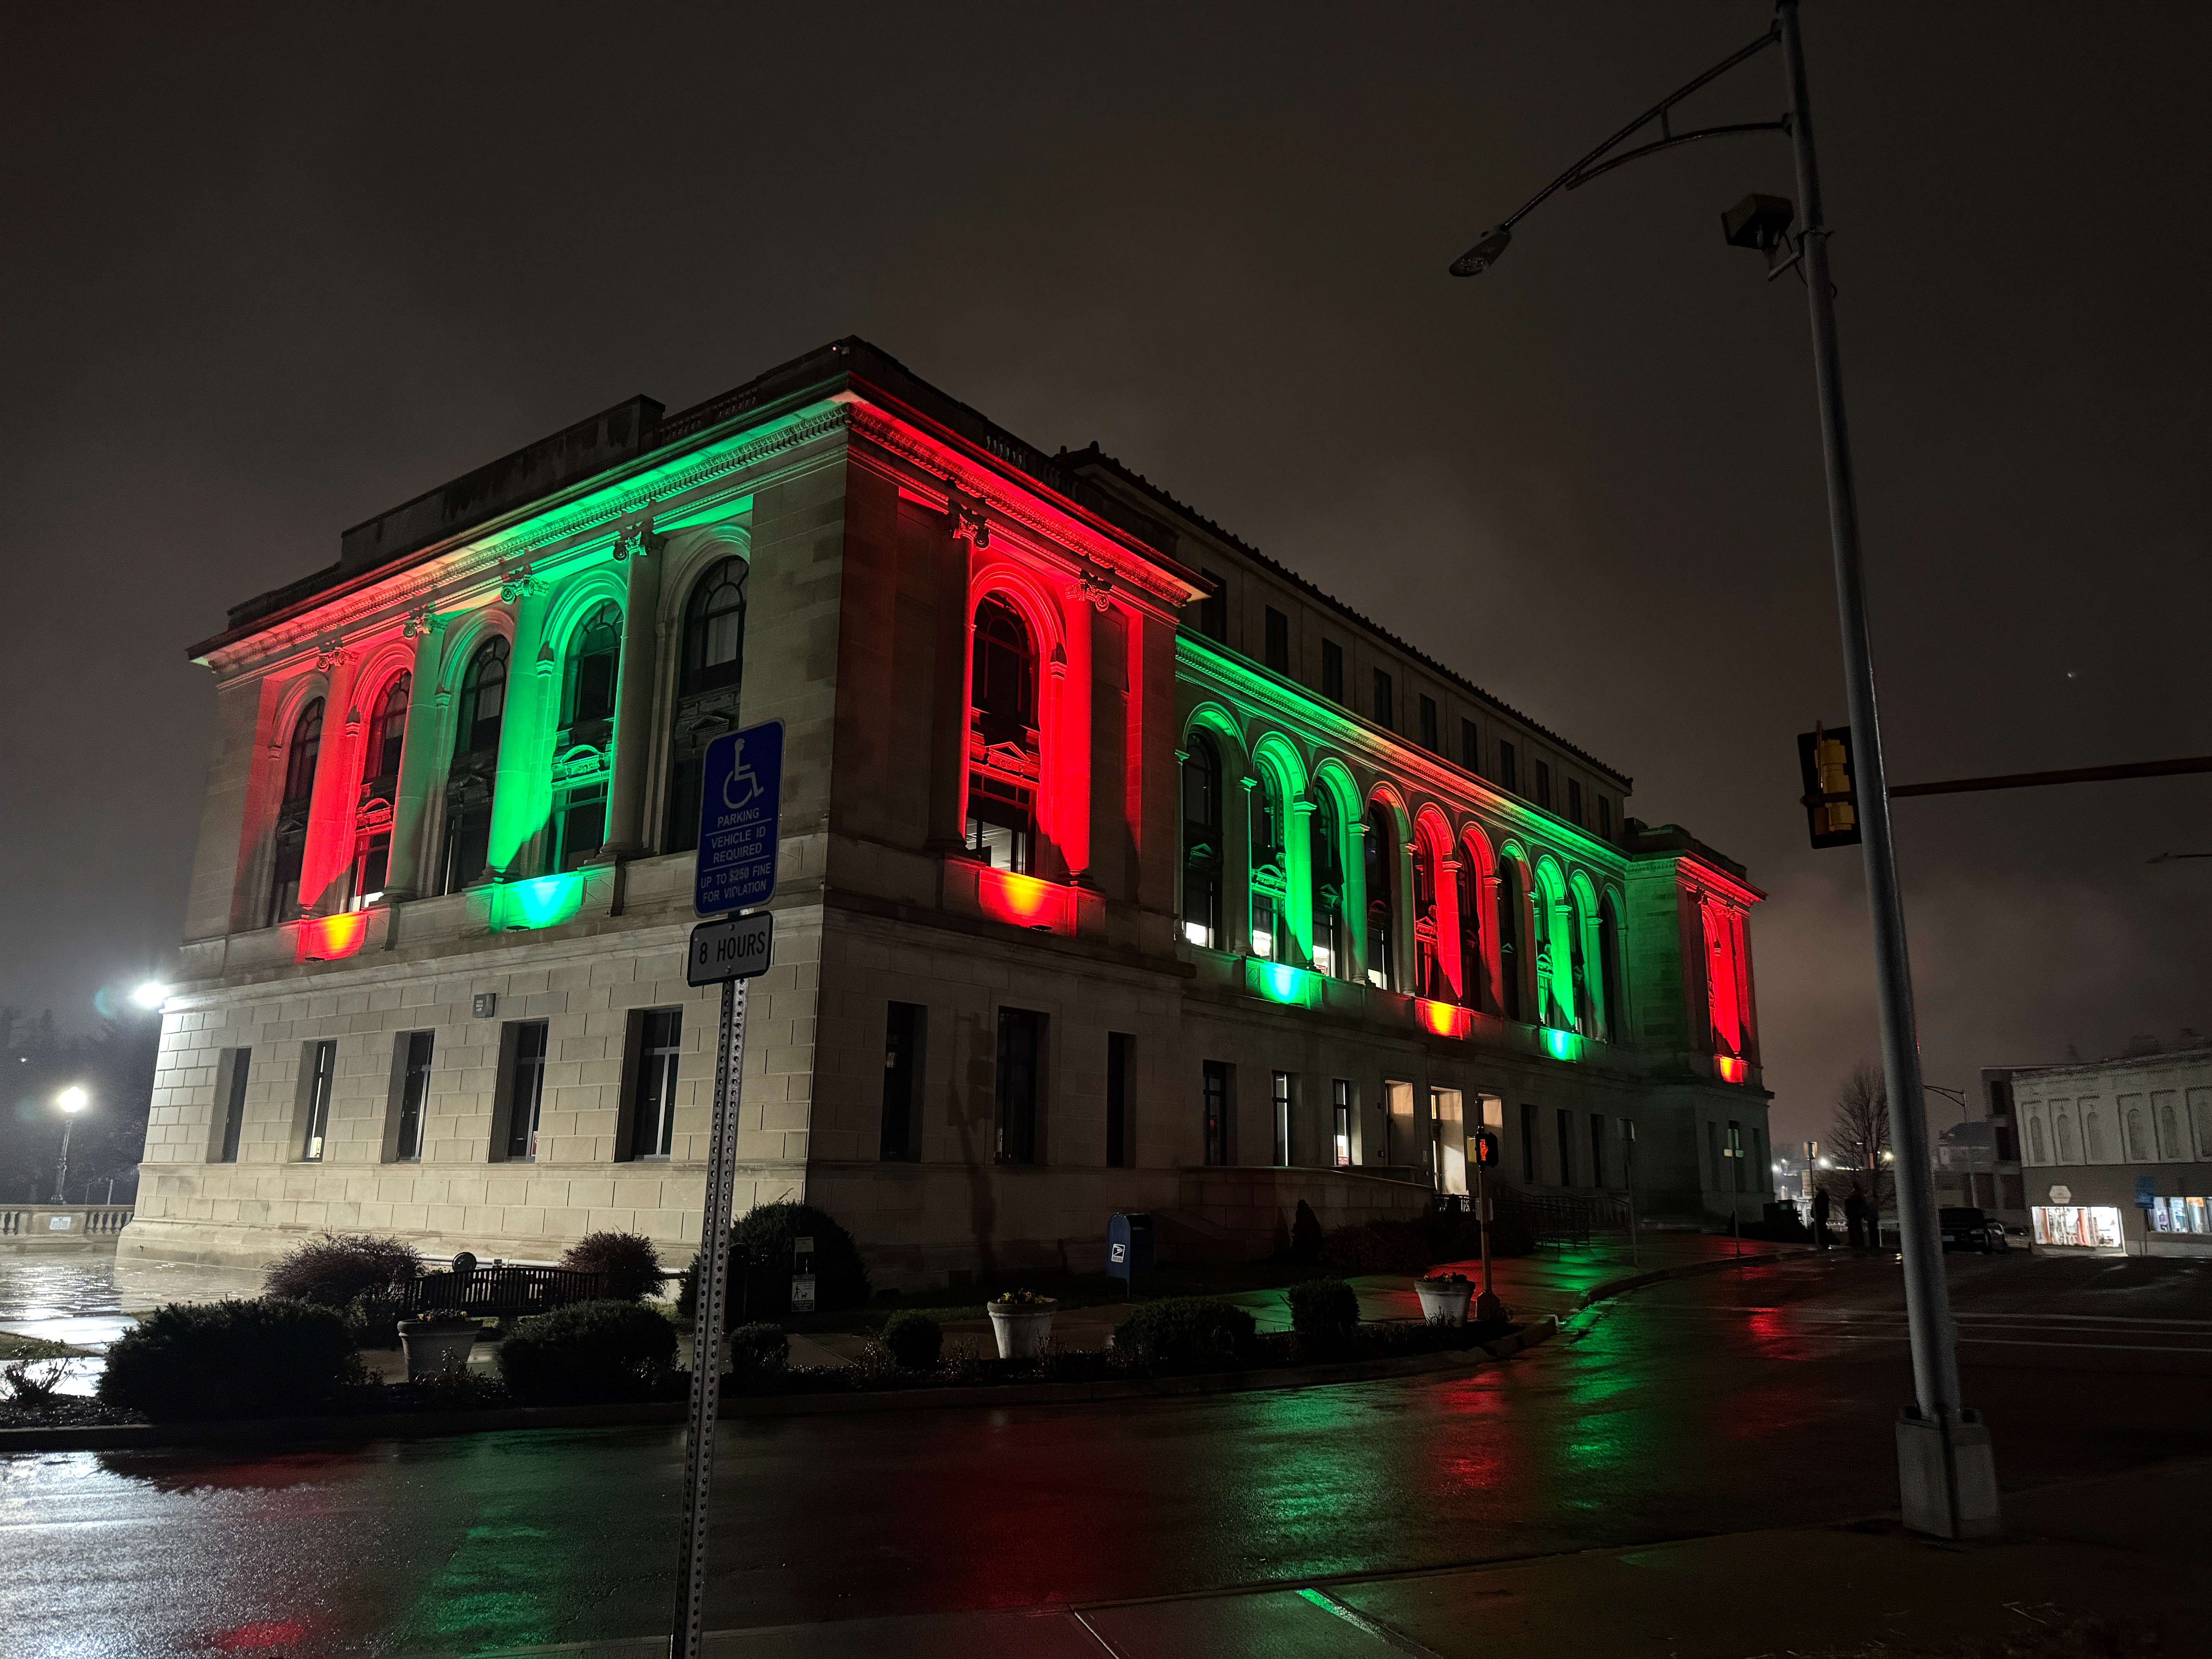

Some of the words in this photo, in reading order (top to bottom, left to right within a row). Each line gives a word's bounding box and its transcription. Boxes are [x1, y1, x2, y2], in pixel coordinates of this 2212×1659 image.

[717, 807, 759, 828] PARKING
[711, 830, 751, 849] VEHICLE
[756, 826, 766, 838] ID
[713, 843, 762, 864] REQUIRED
[701, 876, 712, 888] UP
[716, 873, 726, 885] TO
[729, 867, 749, 883] $250
[752, 863, 771, 877] FINE
[702, 890, 719, 903] FOR
[724, 879, 767, 899] VIOLATION
[699, 942, 708, 965] 8
[717, 931, 766, 962] HOURS
